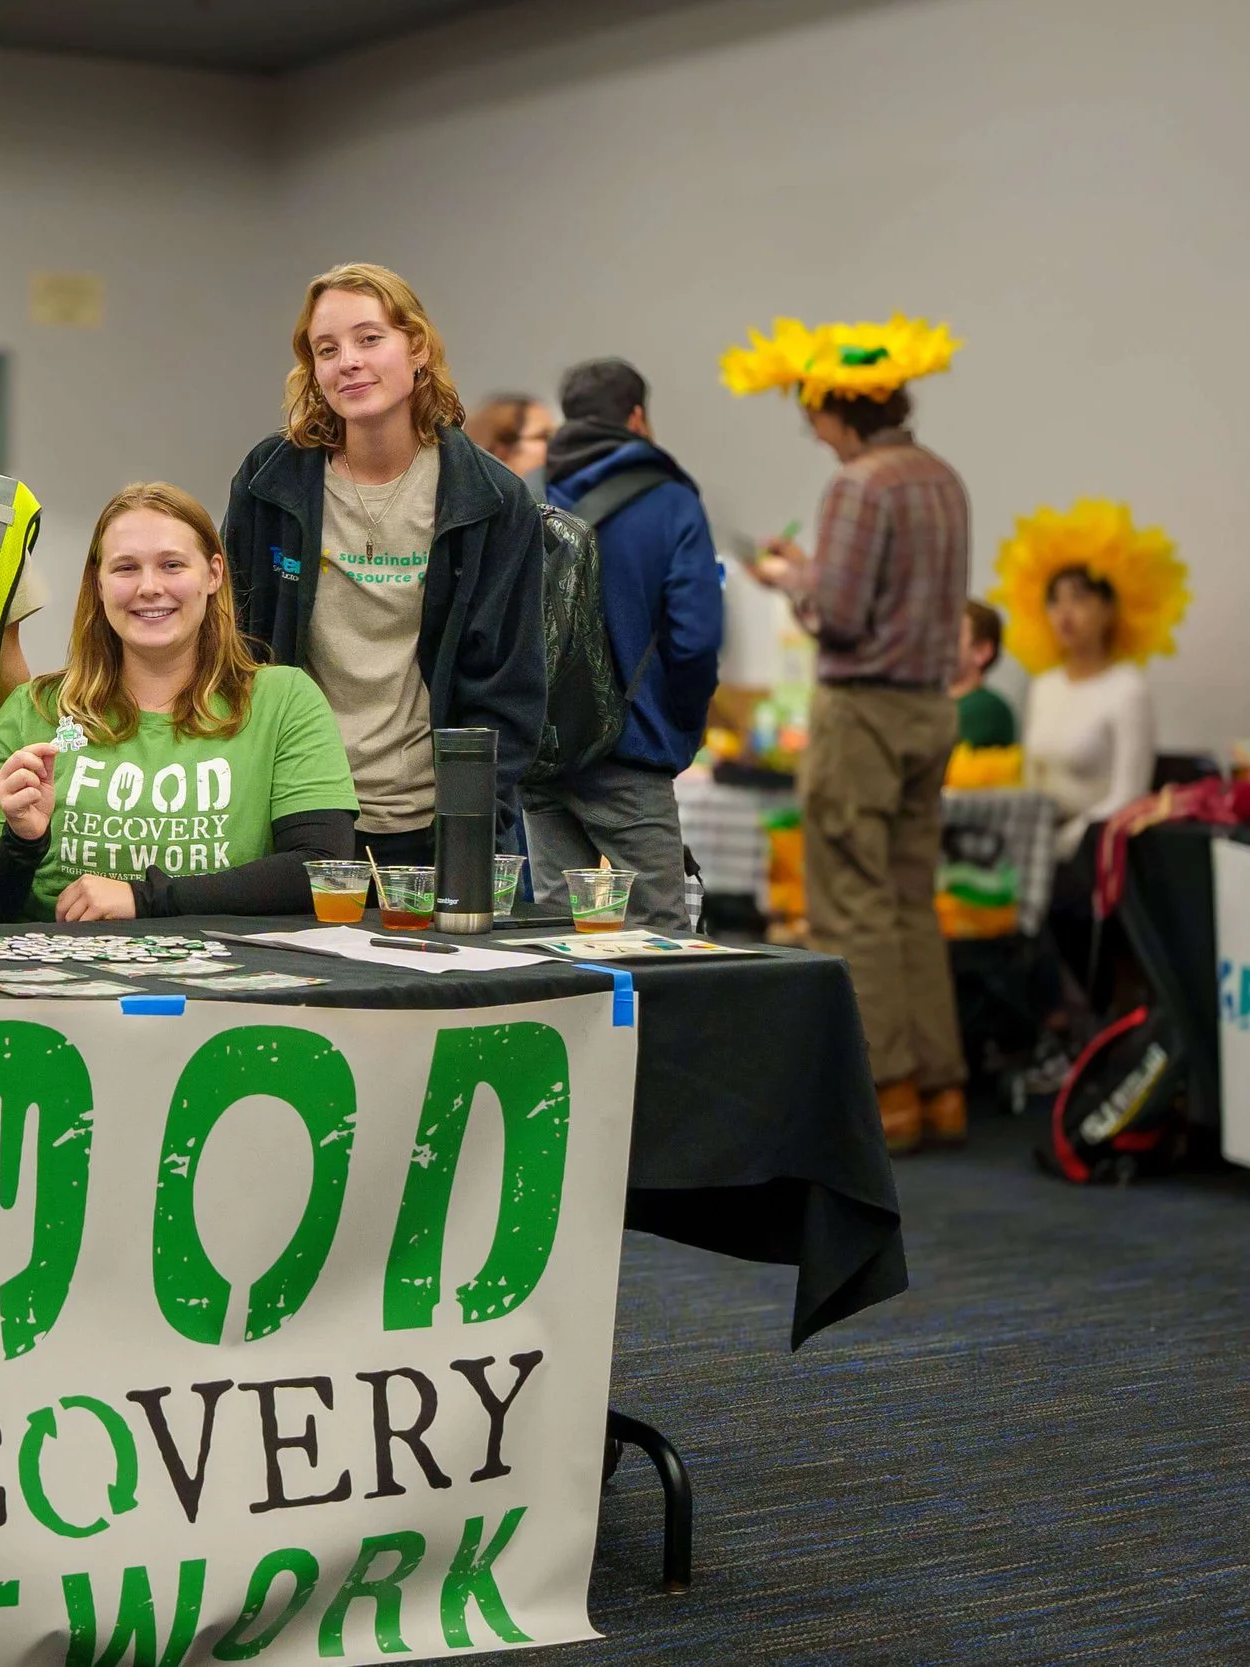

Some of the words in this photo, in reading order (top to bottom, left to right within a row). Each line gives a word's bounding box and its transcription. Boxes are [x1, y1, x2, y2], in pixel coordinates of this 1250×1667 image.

[339, 551, 428, 566] susainabi
[344, 570, 412, 584] esource
[65, 755, 232, 814] FOOD
[61, 810, 230, 841] RECOVERY
[60, 836, 231, 872] NETWORK
